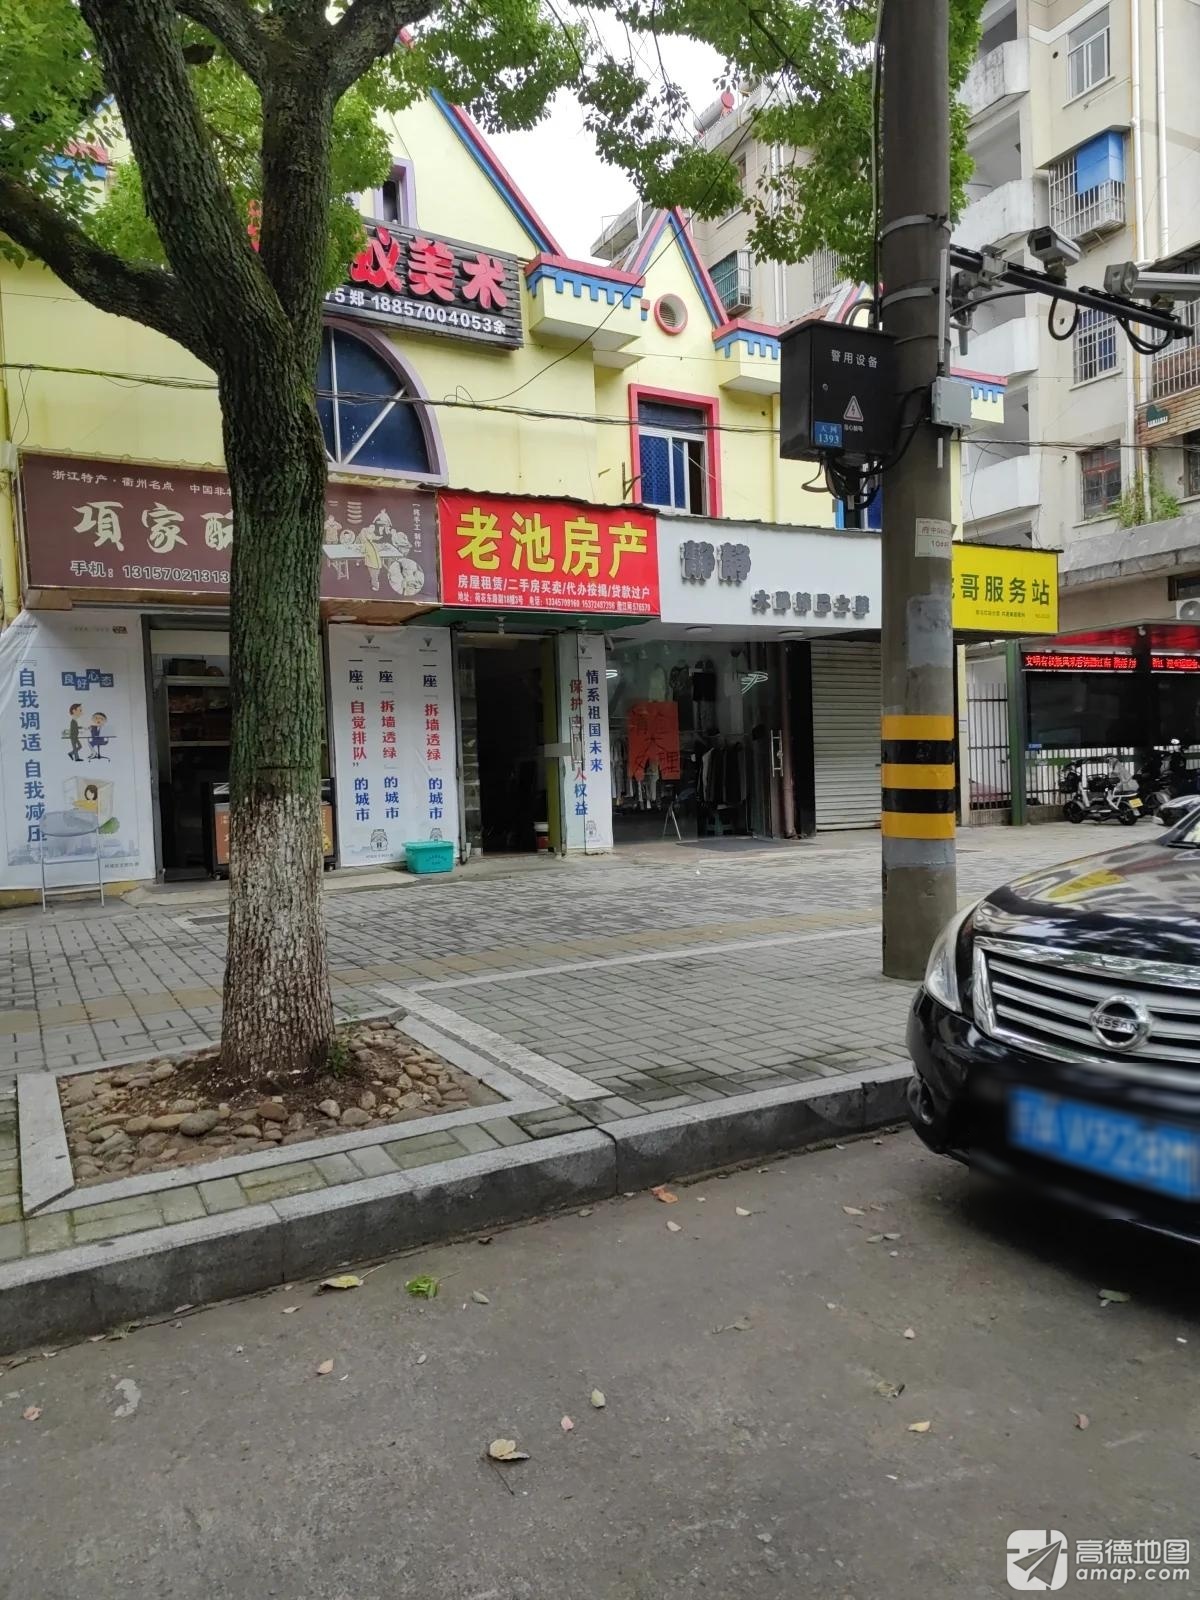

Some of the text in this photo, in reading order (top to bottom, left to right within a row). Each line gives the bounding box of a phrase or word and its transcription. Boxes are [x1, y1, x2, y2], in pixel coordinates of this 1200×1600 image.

[831, 349, 878, 369] 警用设备
[818, 433, 840, 444] 1393
[456, 507, 648, 579] 老池房产
[457, 573, 650, 600] 房屋租赁/二手房买卖/代办按揭/贷款过户
[62, 668, 114, 691] 良好心态
[17, 667, 43, 752] 自我调适
[586, 669, 604, 772] 情系祖国未来
[569, 679, 589, 816] 保护人权益
[1092, 1015, 1140, 1032] NISSAN
